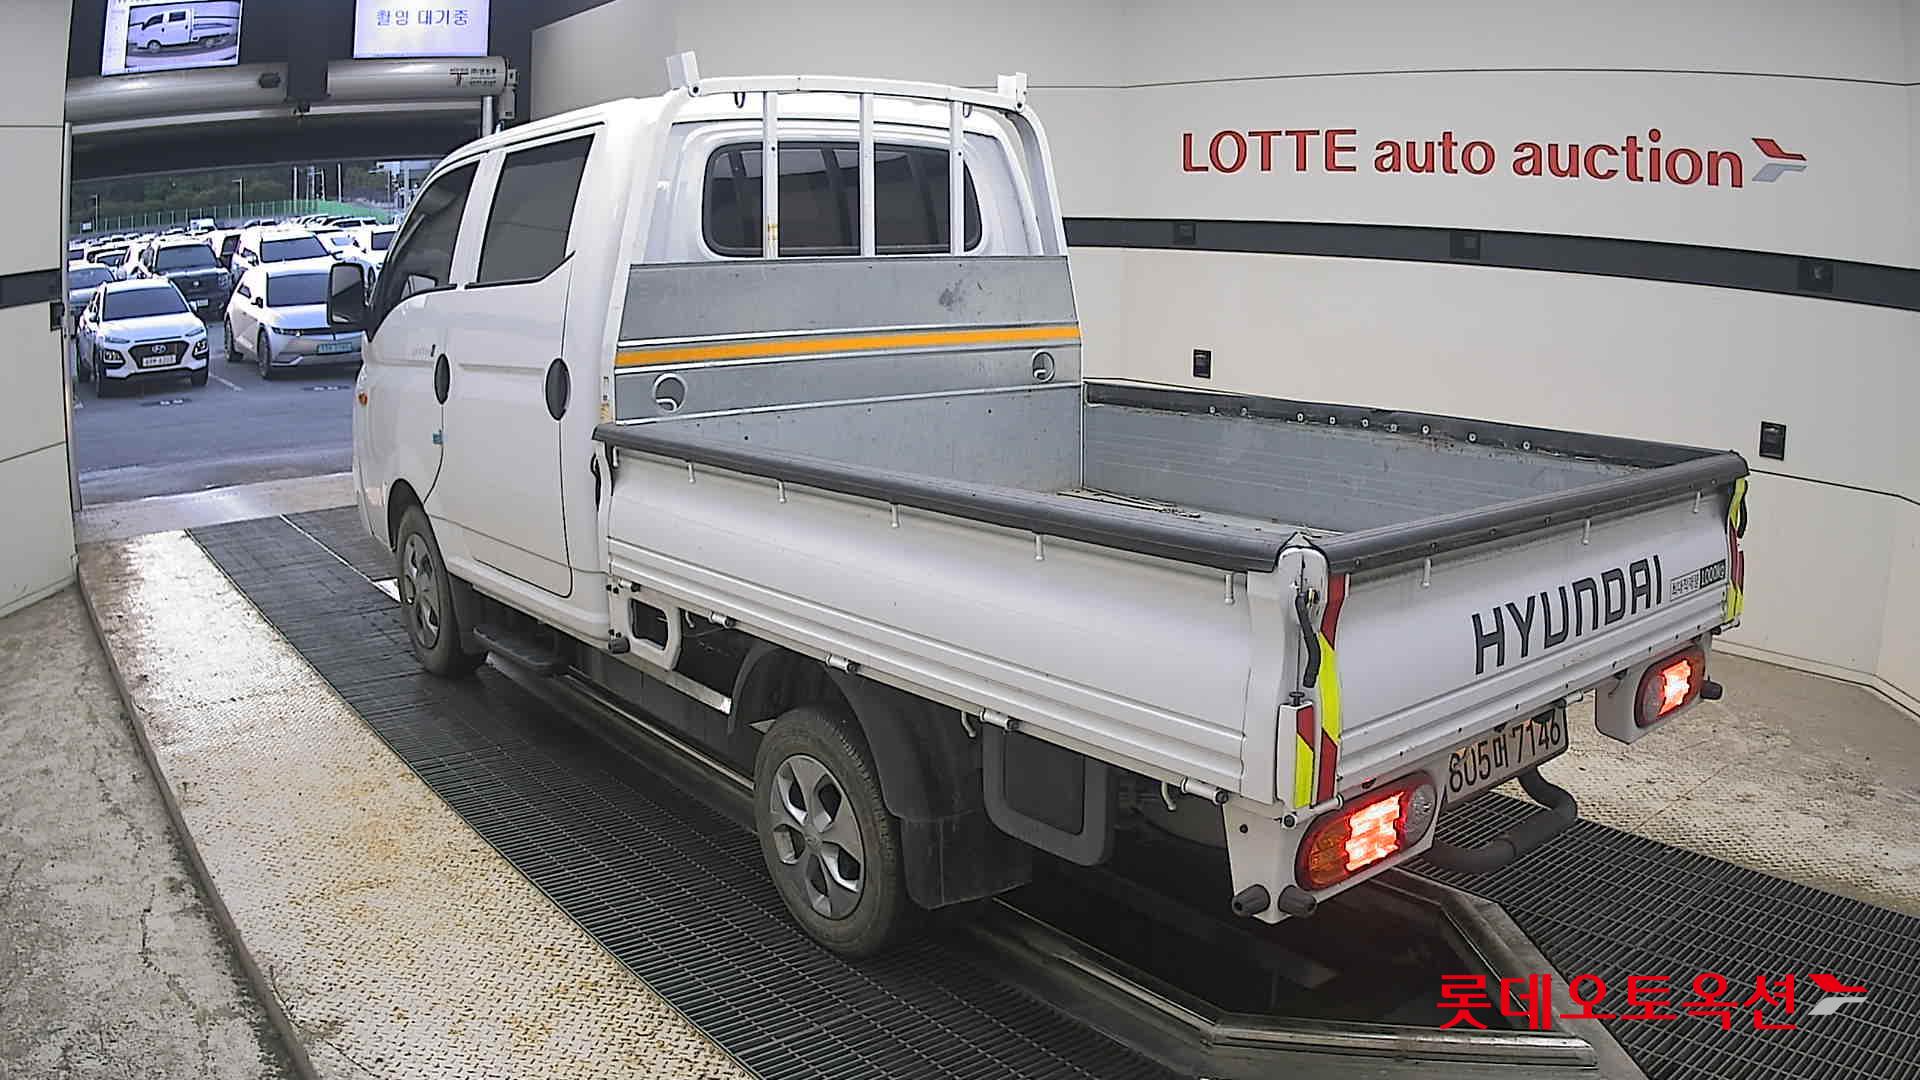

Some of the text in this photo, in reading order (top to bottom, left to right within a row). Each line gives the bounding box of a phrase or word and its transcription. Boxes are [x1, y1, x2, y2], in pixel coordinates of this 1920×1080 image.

[417, 9, 469, 26] 대기중
[1183, 129, 1744, 188] LOTTE auto auction
[1471, 554, 1662, 675] HYUNDAI
